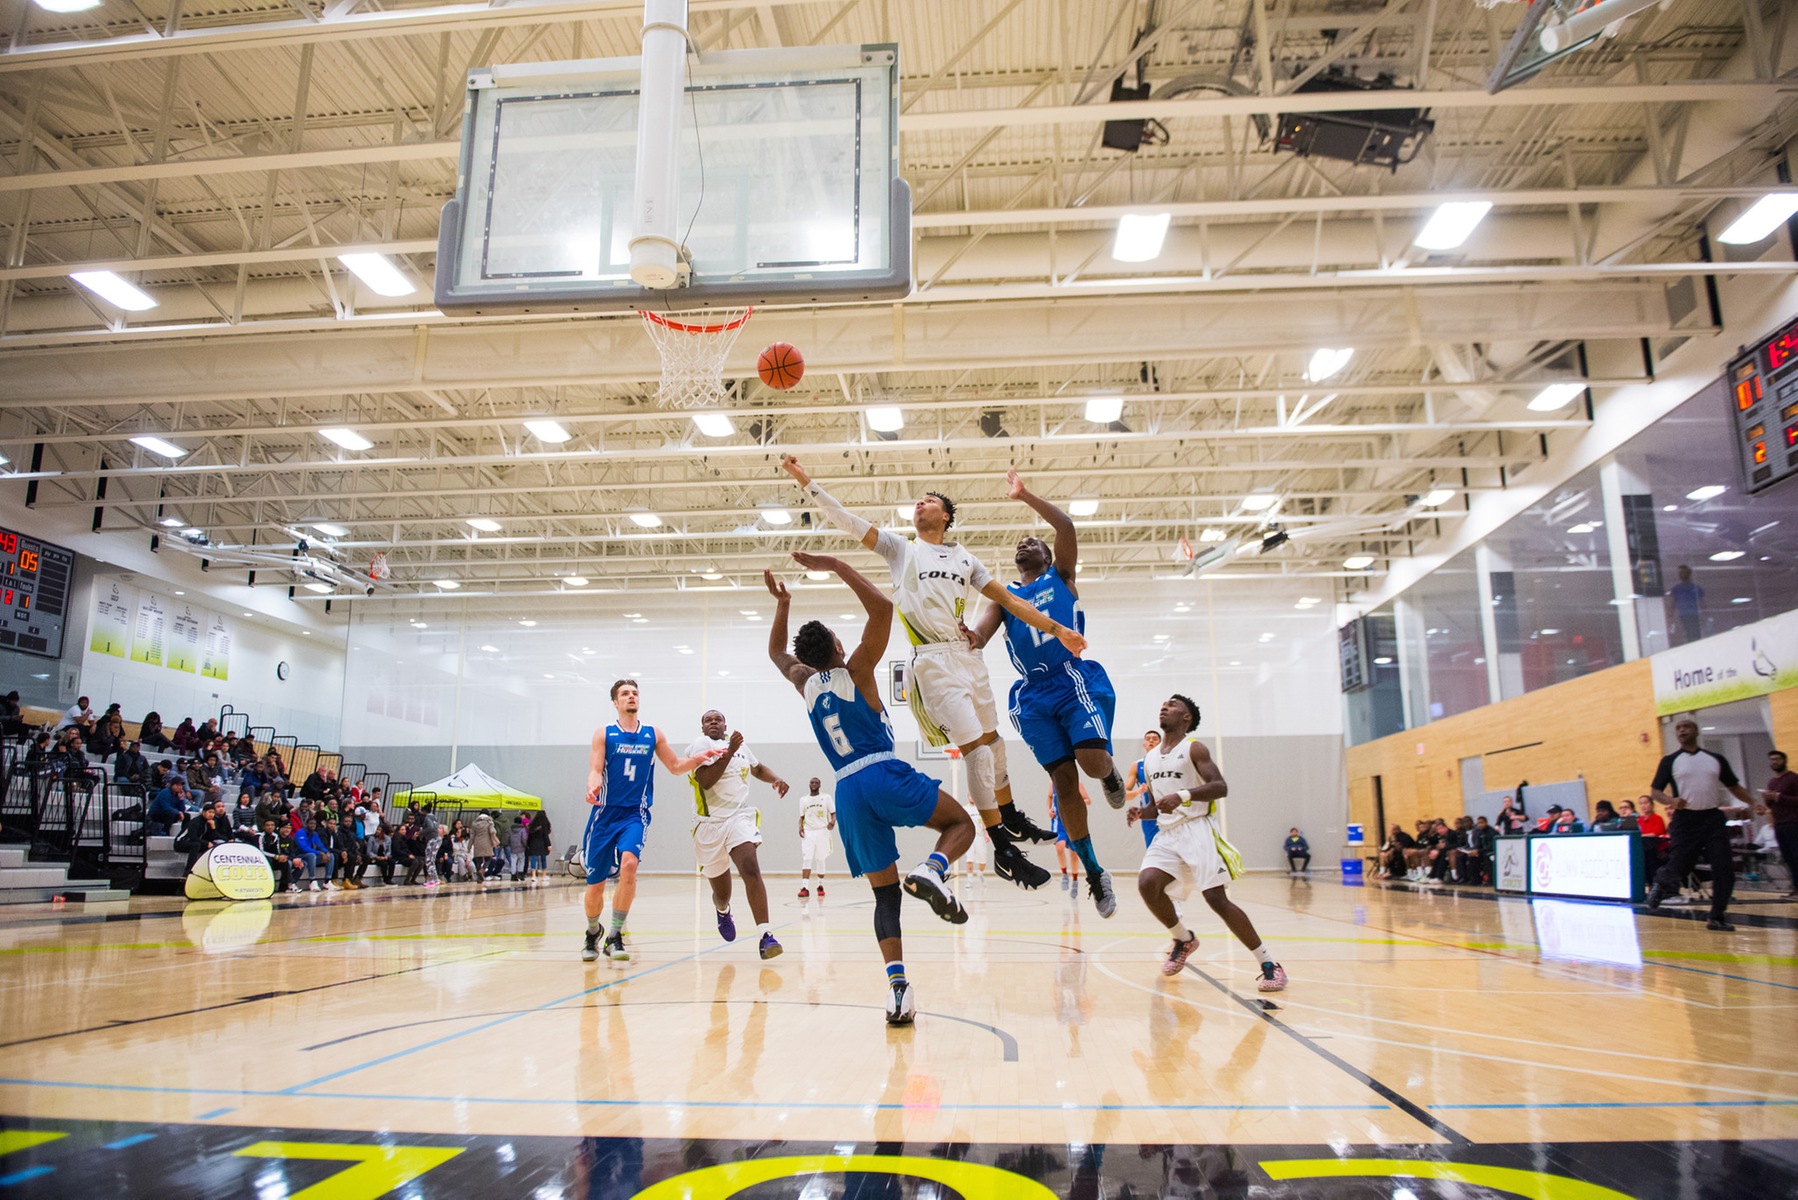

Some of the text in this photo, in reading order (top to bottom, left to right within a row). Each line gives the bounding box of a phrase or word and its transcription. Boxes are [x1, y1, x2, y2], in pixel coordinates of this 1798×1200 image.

[1754, 441, 1767, 464] 2
[20, 550, 38, 572] 05
[918, 570, 966, 586] COLTS
[4, 588, 14, 605] 2
[24, 595, 31, 608] 1
[1673, 666, 1713, 690] Home
[822, 712, 855, 758] 6
[623, 757, 637, 782] 4
[213, 854, 265, 865] CENTENNIAL
[216, 864, 269, 881] COLTS
